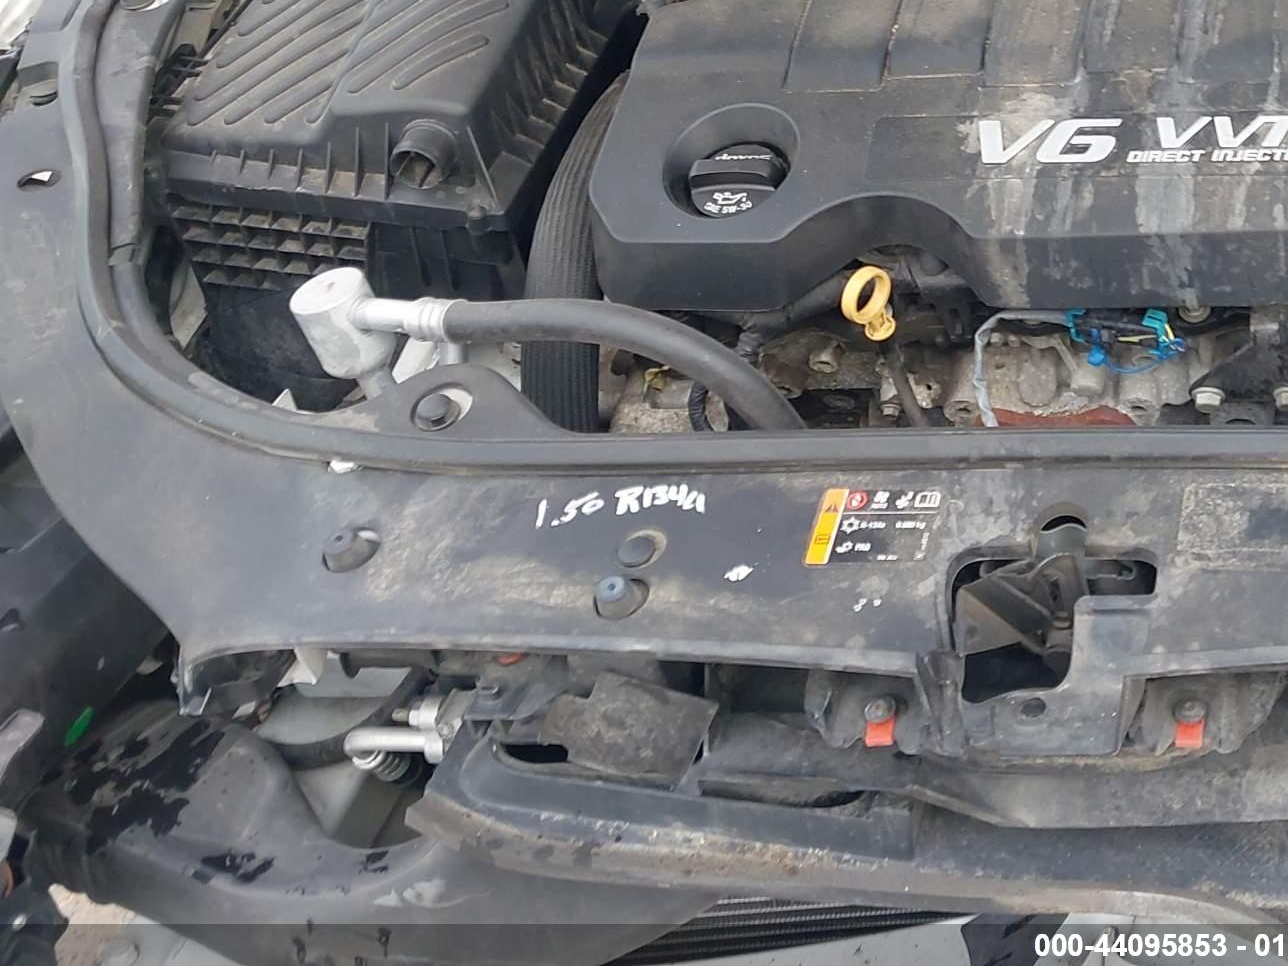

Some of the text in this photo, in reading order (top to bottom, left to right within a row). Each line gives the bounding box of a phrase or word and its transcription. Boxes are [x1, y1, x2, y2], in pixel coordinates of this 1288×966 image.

[978, 119, 1122, 164] V6
[1126, 150, 1207, 164] DIRECT
[535, 491, 605, 529] 1.50
